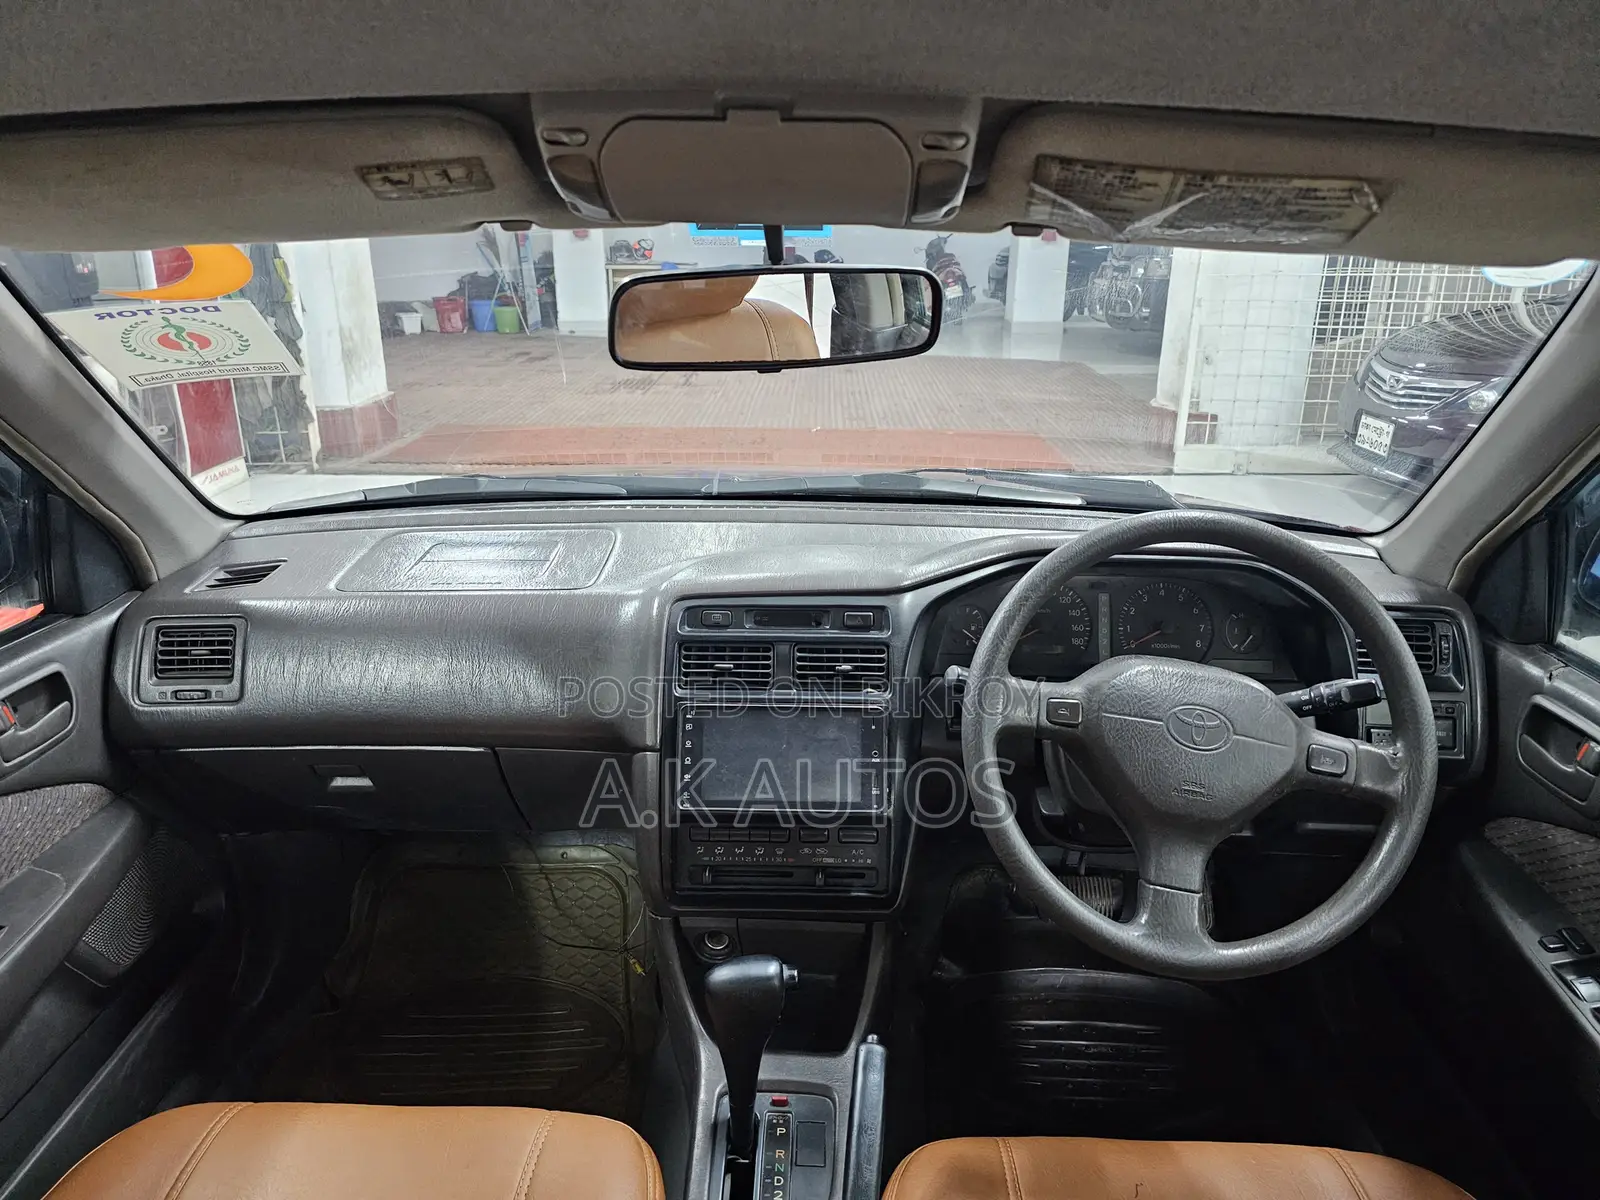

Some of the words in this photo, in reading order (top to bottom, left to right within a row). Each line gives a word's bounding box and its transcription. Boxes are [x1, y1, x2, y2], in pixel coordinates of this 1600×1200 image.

[1059, 596, 1072, 604] 120
[1068, 609, 1081, 617] 140
[1130, 607, 1136, 615] 2
[1071, 624, 1085, 632] 160
[1199, 624, 1205, 632] 7
[1195, 640, 1201, 648] 8
[776, 1127, 786, 1136] P
[775, 1149, 785, 1159] R
[774, 1163, 785, 1172] N
[774, 1176, 784, 1186] D
[773, 1190, 783, 1200] 2
